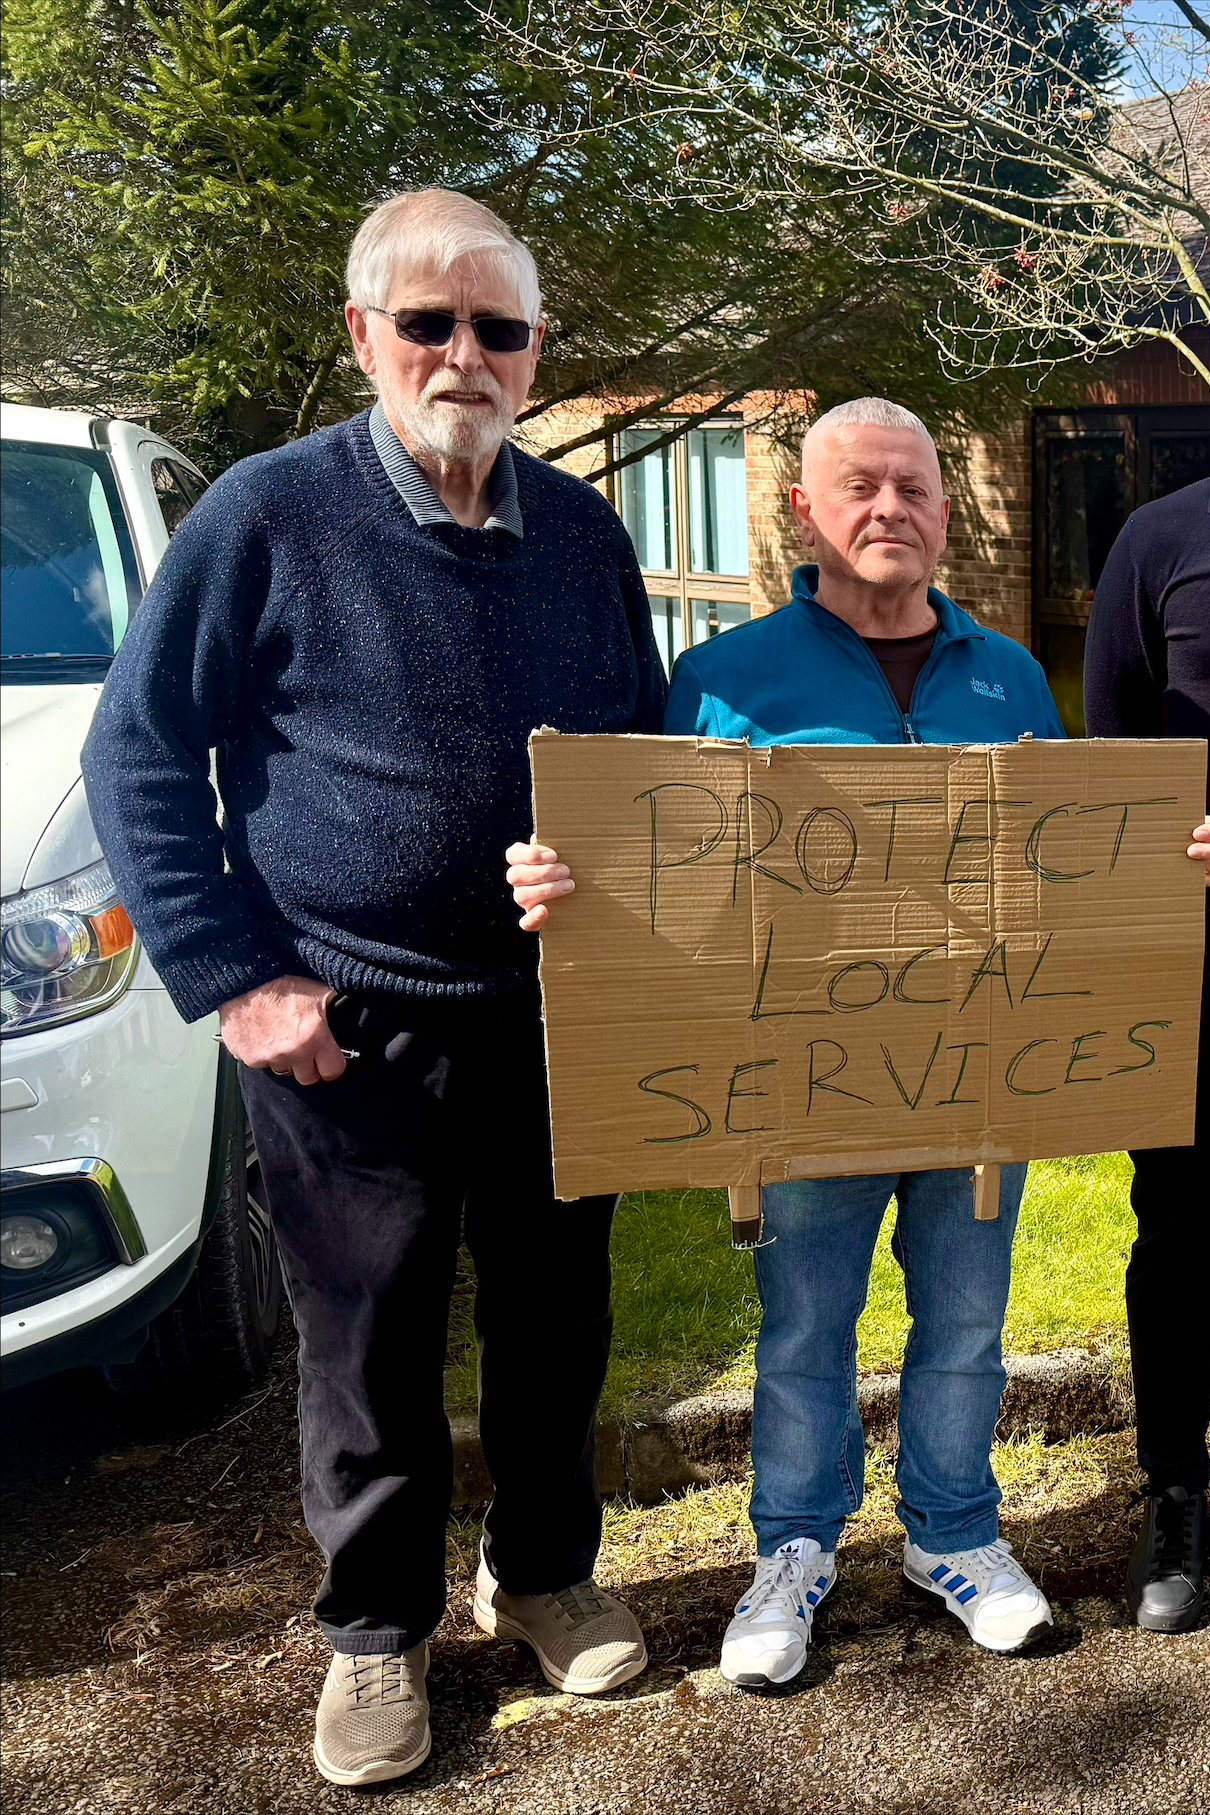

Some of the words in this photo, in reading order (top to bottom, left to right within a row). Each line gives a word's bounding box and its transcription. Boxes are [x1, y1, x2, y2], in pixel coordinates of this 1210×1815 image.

[969, 676, 990, 690] Jack
[971, 684, 1006, 701] Wolfskin
[633, 782, 1178, 935] PROTECT
[750, 922, 1095, 1021] LOCAL
[635, 1020, 1173, 1145] SERVICES
